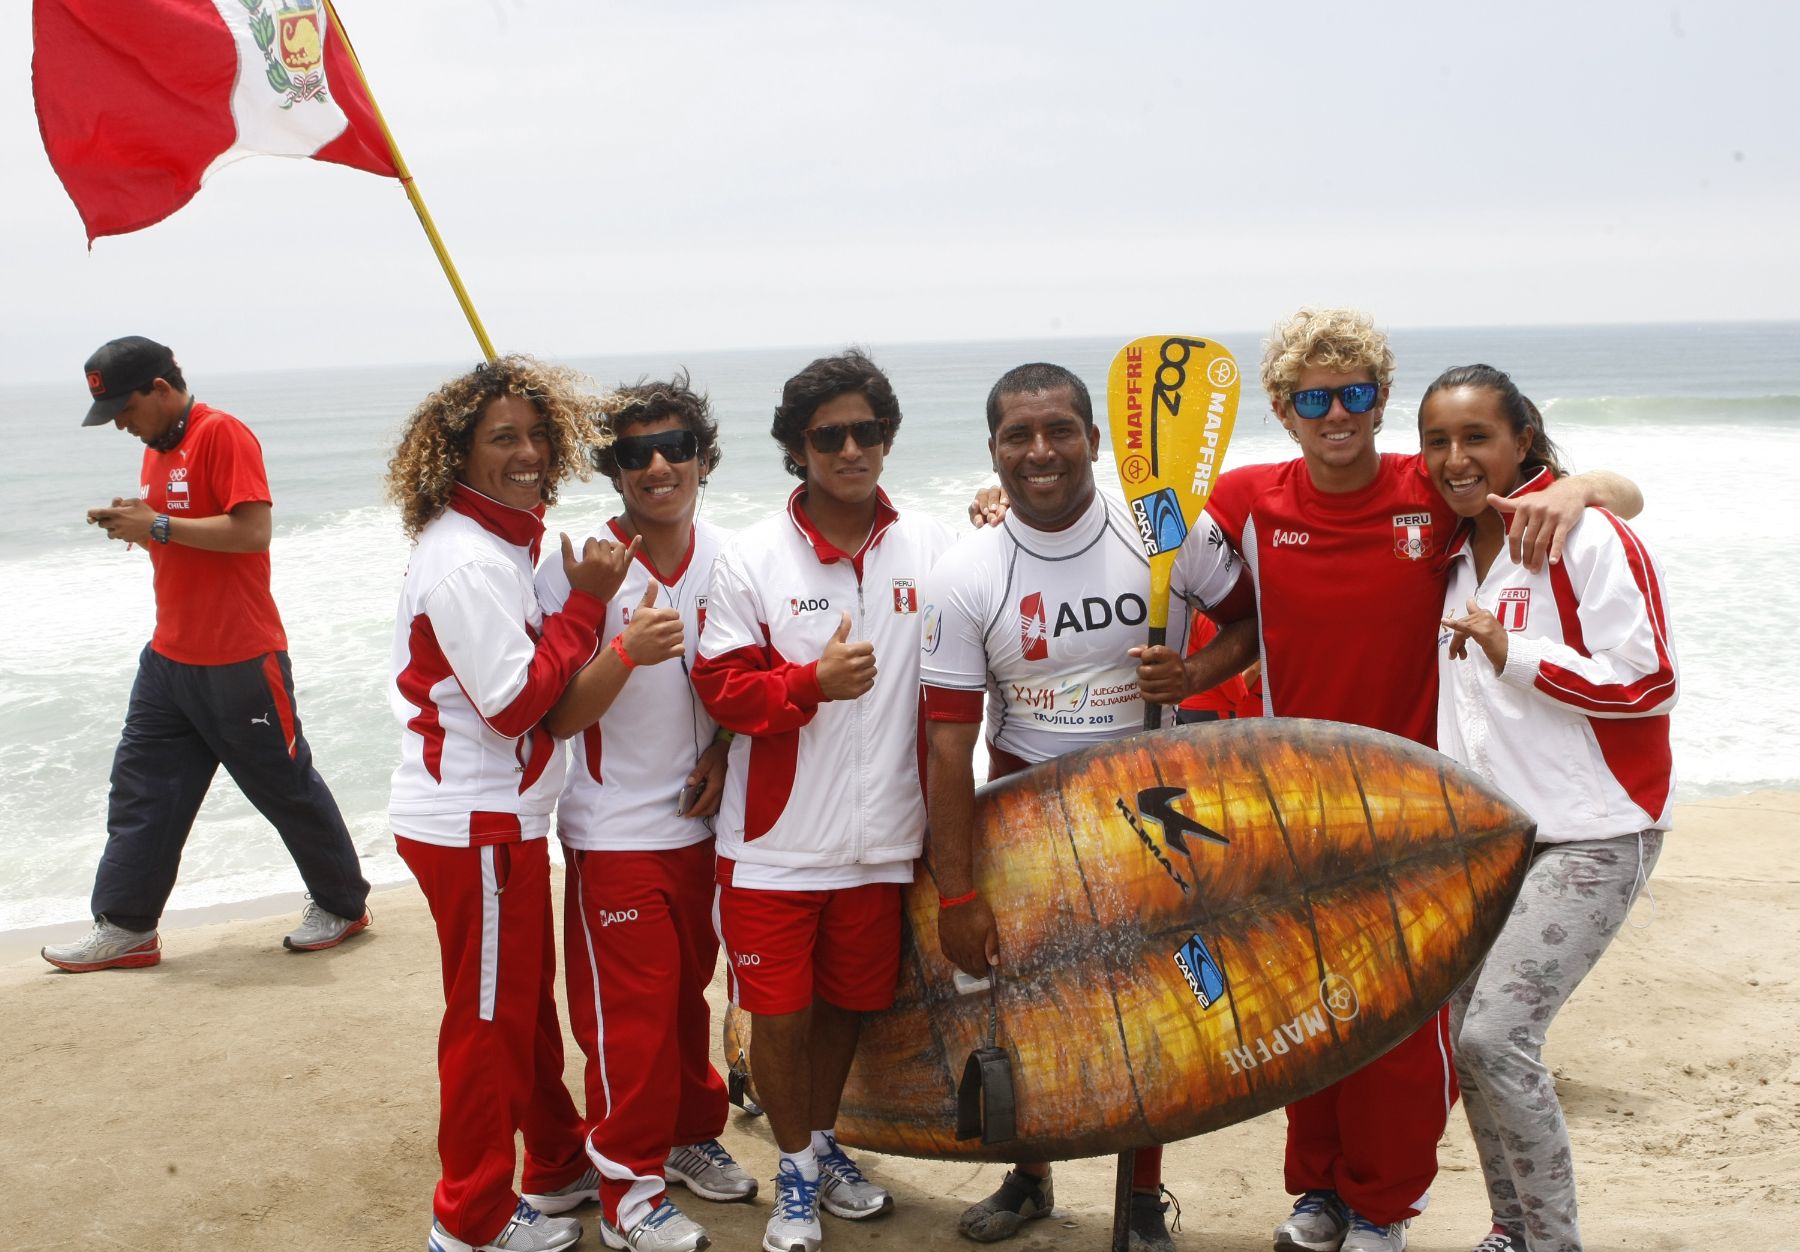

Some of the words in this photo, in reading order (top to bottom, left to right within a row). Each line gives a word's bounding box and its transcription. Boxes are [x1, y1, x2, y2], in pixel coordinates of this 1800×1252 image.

[1126, 346, 1143, 449] MAPFRE
[1191, 391, 1227, 497] MAPFRE
[167, 502, 190, 510] CHILE
[1395, 514, 1429, 526] PERU
[1278, 531, 1310, 546] ADO
[1501, 590, 1527, 598] PERU
[799, 598, 830, 612] ADO
[1052, 592, 1148, 638] ADO
[1012, 683, 1055, 710] XVII
[1091, 685, 1123, 697] JUEGOS
[1090, 692, 1142, 707] BOLIVARIANO
[1033, 712, 1084, 725] TRUJILLO
[1089, 714, 1114, 725] 2013
[1116, 797, 1190, 895] KLIMAX
[607, 908, 639, 924] ADO
[737, 953, 761, 966] ADO
[1220, 1005, 1328, 1075] MAPFRE
